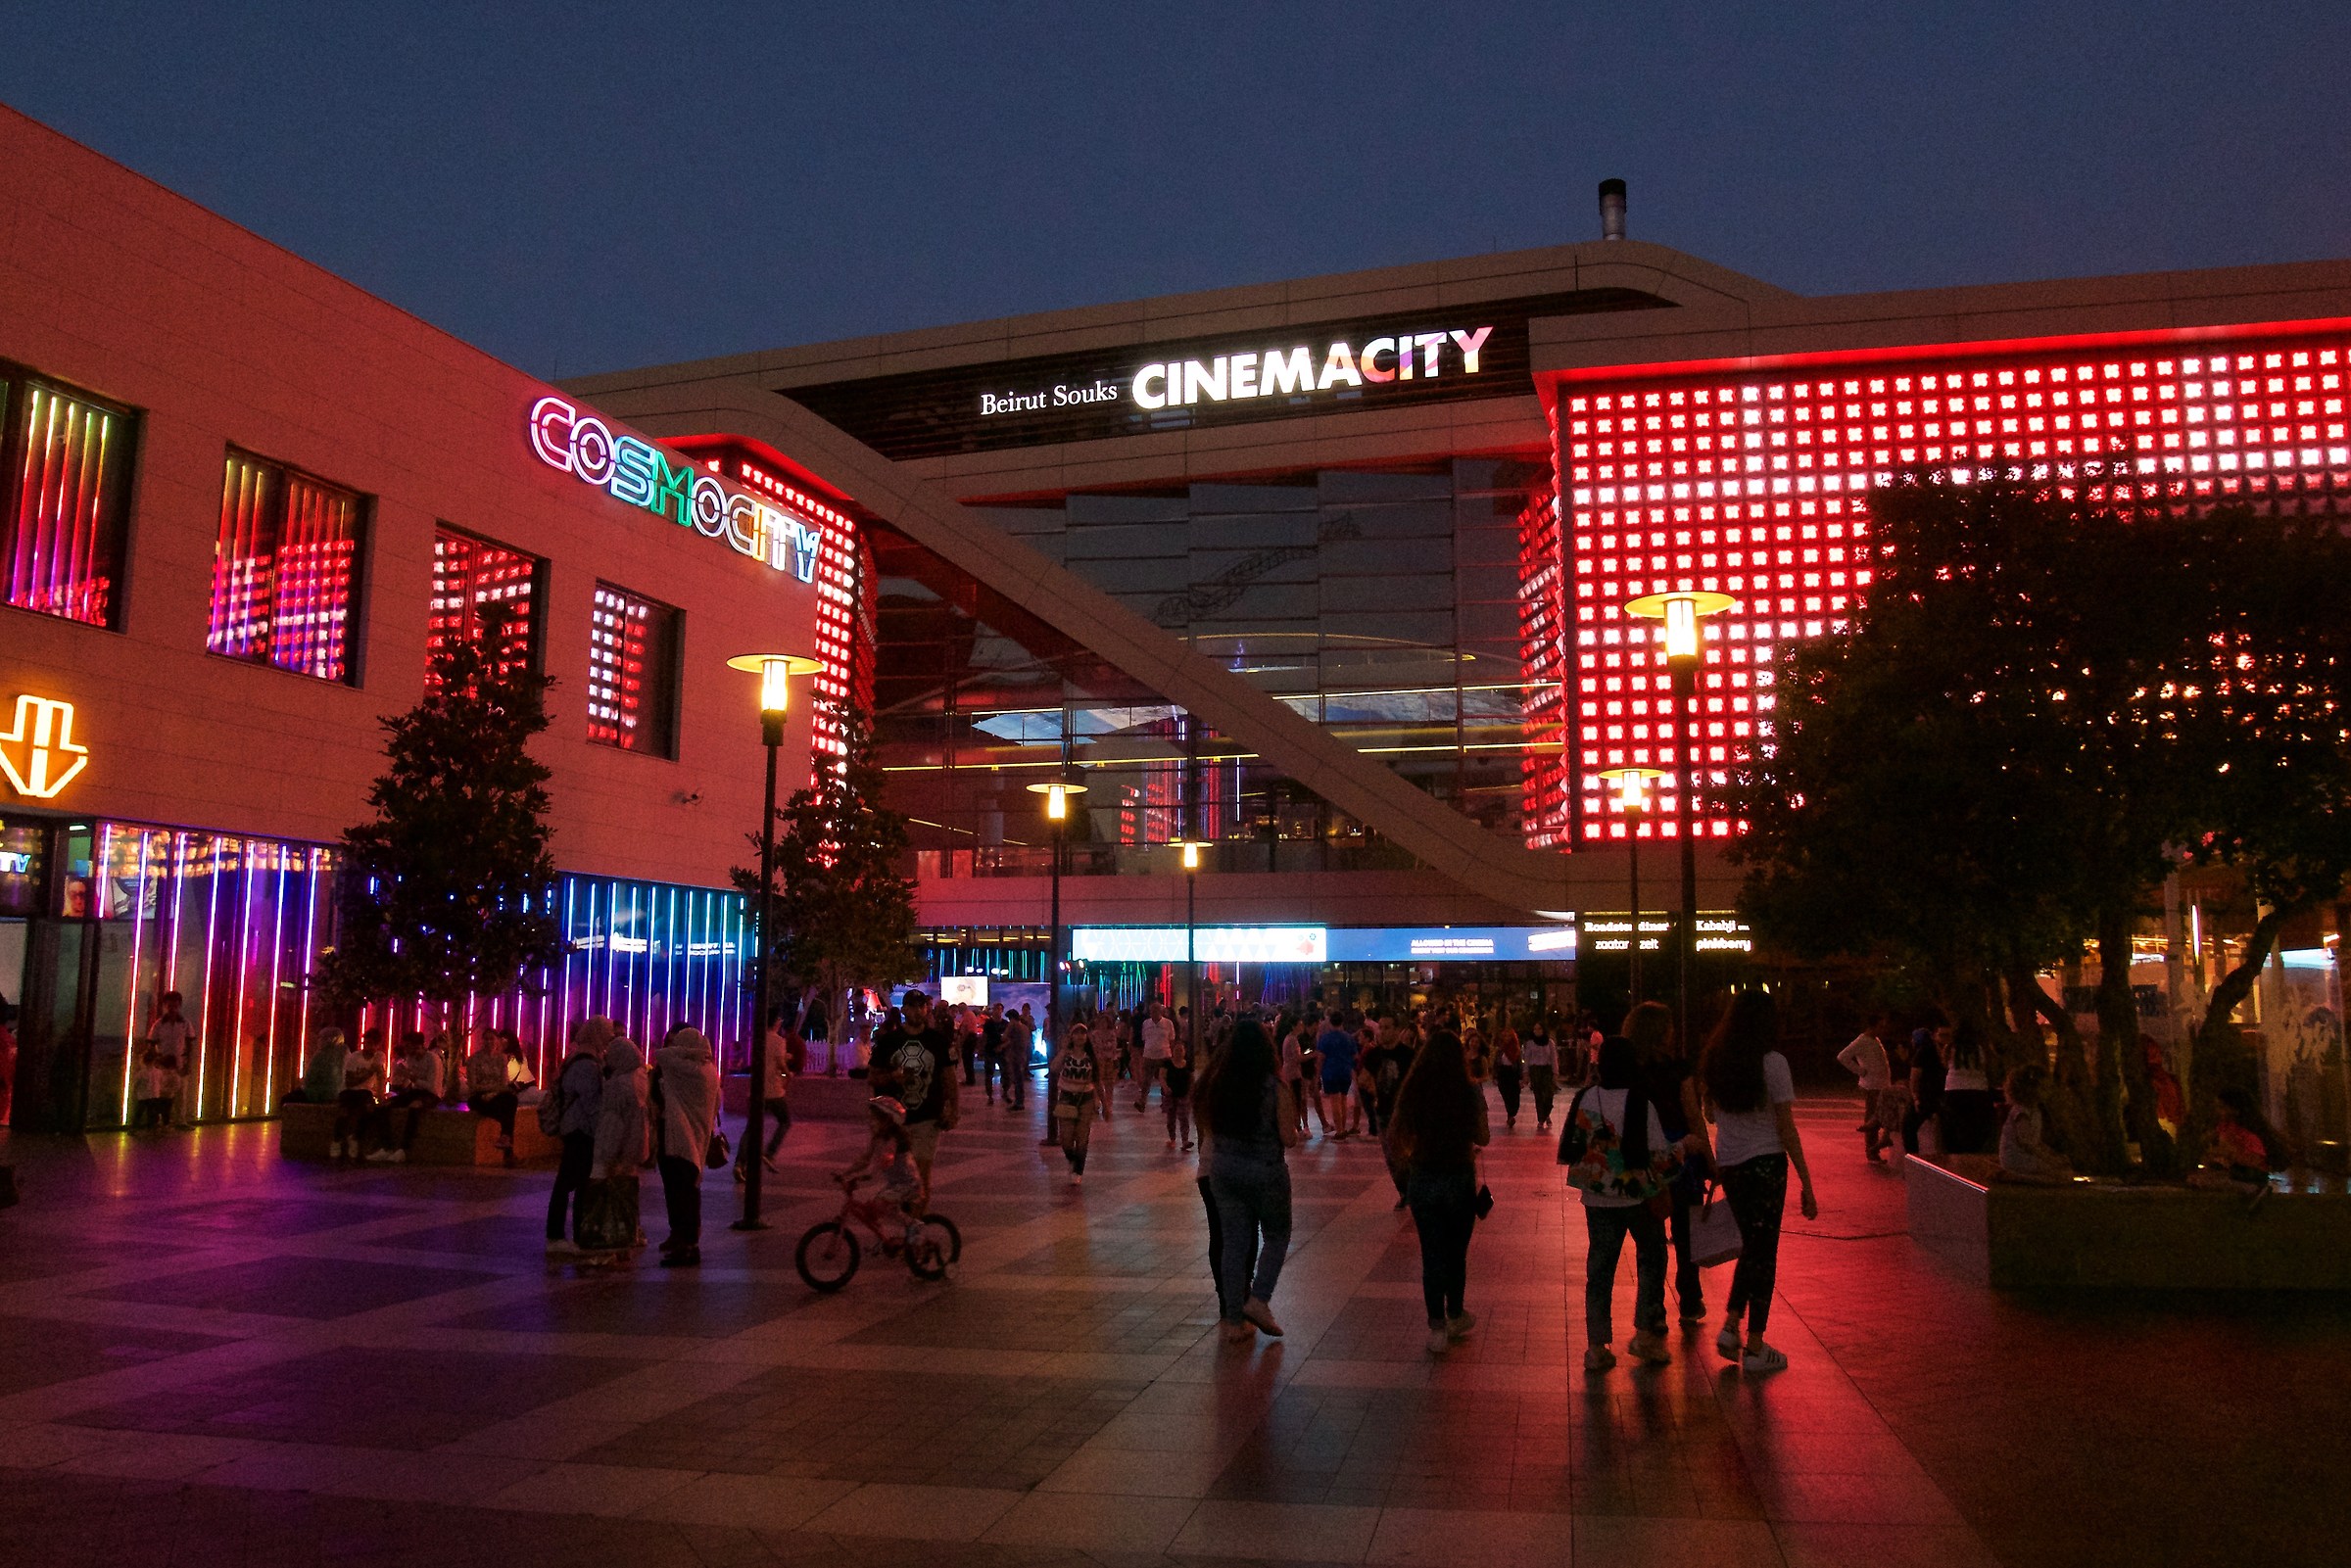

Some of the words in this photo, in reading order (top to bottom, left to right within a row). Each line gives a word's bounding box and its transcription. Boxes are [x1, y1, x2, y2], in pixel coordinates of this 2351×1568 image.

[981, 391, 1047, 415] Beirut
[1053, 380, 1118, 406] Souks
[1130, 326, 1494, 410] CINEMACITY
[530, 397, 822, 584] COSMOCITY
[1639, 937, 1659, 950] zeit
[1696, 936, 1751, 952] pinkberry
